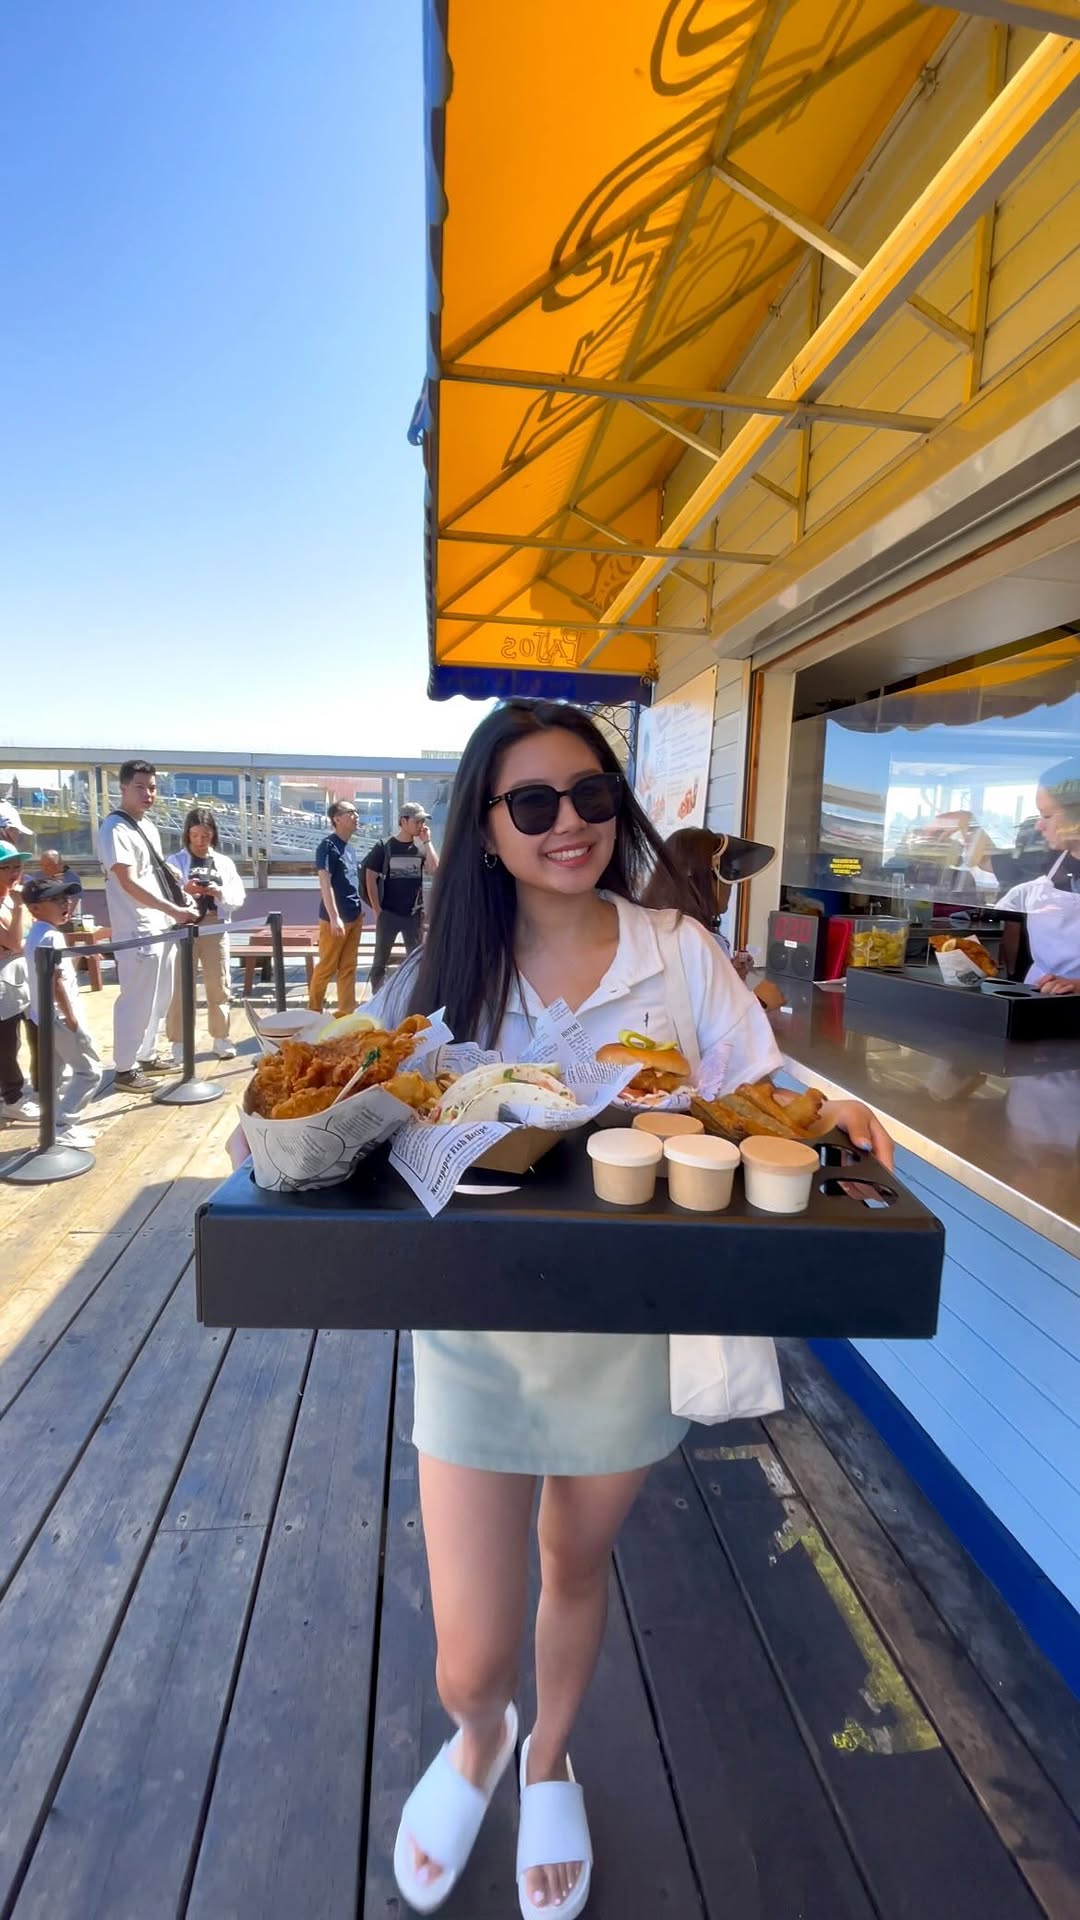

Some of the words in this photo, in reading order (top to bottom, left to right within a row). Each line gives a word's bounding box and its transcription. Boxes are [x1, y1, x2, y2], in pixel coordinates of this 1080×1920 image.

[430, 1153, 453, 1196] Newspaper
[450, 1138, 467, 1155] Fish
[465, 1125, 488, 1142] Recipe
